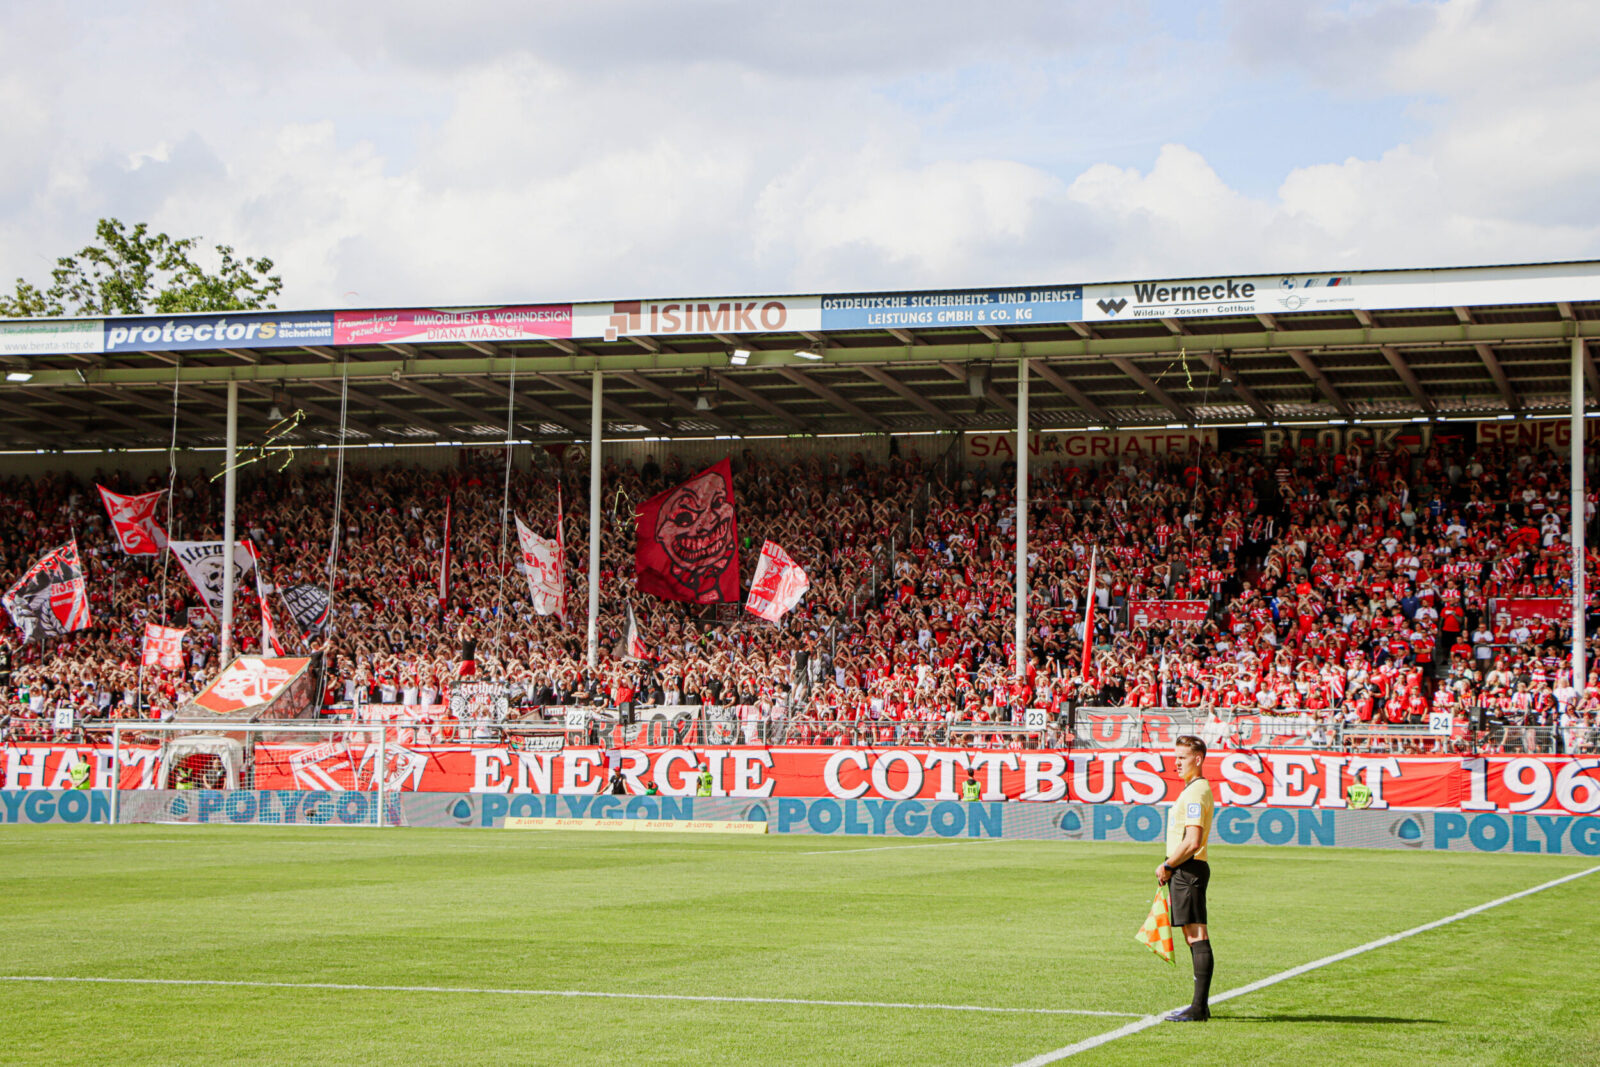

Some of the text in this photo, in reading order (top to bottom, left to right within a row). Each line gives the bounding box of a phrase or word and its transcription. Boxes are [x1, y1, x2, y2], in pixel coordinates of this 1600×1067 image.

[1134, 280, 1255, 303] Wernecke
[823, 290, 1080, 311] OSTDEUTSCHE SICHERHEITS- UND DIENST-
[413, 311, 570, 326] IMMOBILIEN & WOHNDESIGN
[650, 301, 787, 333] ISIMKO
[868, 308, 1033, 325] LEISTUNGS GMBH & CO. KG
[1133, 305, 1255, 317] Wildau Zossen Cottbus
[107, 319, 277, 349] protectors
[279, 328, 331, 338] Sicherheit!
[427, 326, 524, 340] DIANA MAASCH
[58, 712, 72, 726] 21
[569, 714, 582, 726] 22
[1029, 712, 1044, 726] 23
[1433, 717, 1448, 730] 24
[469, 748, 775, 797] ENERGIE
[824, 751, 1166, 803] COTTBUS
[1219, 753, 1402, 809] SEIT
[0, 790, 1600, 857] YGON POLYGON POLYGON POLYGON POGON POLYG
